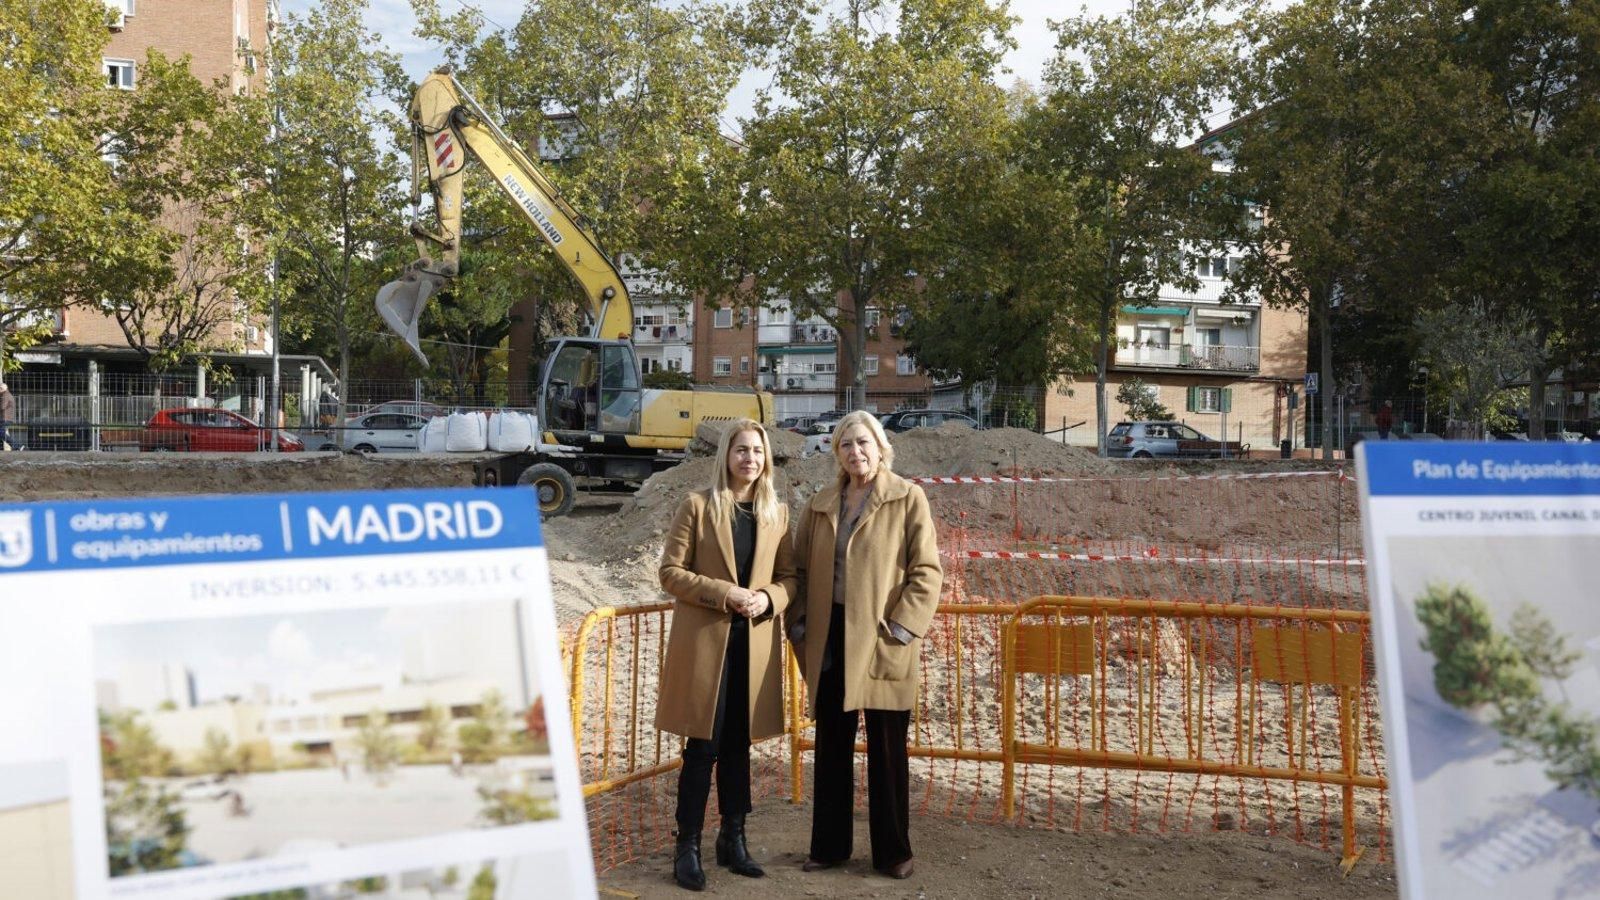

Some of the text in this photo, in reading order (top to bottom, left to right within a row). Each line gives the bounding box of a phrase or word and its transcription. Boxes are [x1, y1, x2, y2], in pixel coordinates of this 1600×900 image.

[504, 175, 562, 243] NEW HOLLAND
[1412, 459, 1453, 478] Plan
[1455, 459, 1479, 479] de
[70, 509, 168, 532] obras y
[306, 500, 503, 545] MADRID
[1418, 509, 1474, 522] CENTRO
[1480, 509, 1536, 522] JUVENIL
[1542, 509, 1587, 522] CANAL
[72, 532, 263, 561] equipamientos
